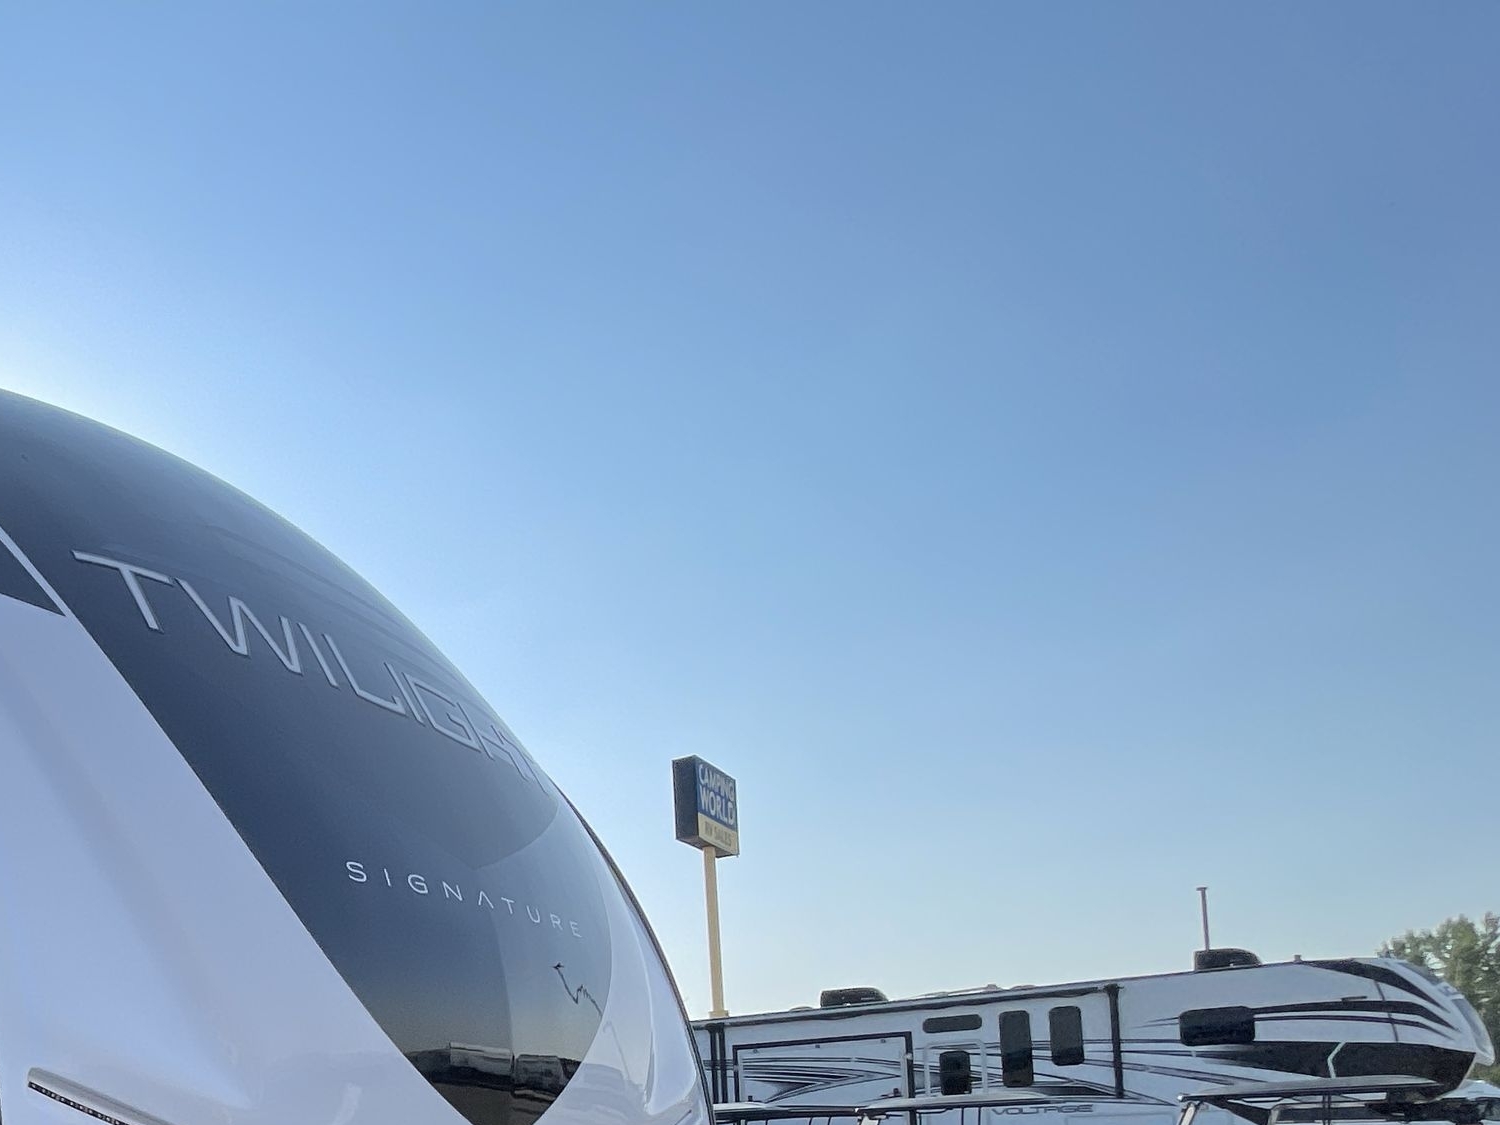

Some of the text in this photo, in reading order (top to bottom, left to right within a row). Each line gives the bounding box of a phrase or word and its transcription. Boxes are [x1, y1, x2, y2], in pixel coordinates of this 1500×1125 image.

[698, 763, 735, 802] CAMPING
[699, 784, 736, 826] WORLD
[345, 860, 582, 938] SIGNATURE
[991, 1104, 1094, 1115] VOLTAGE
